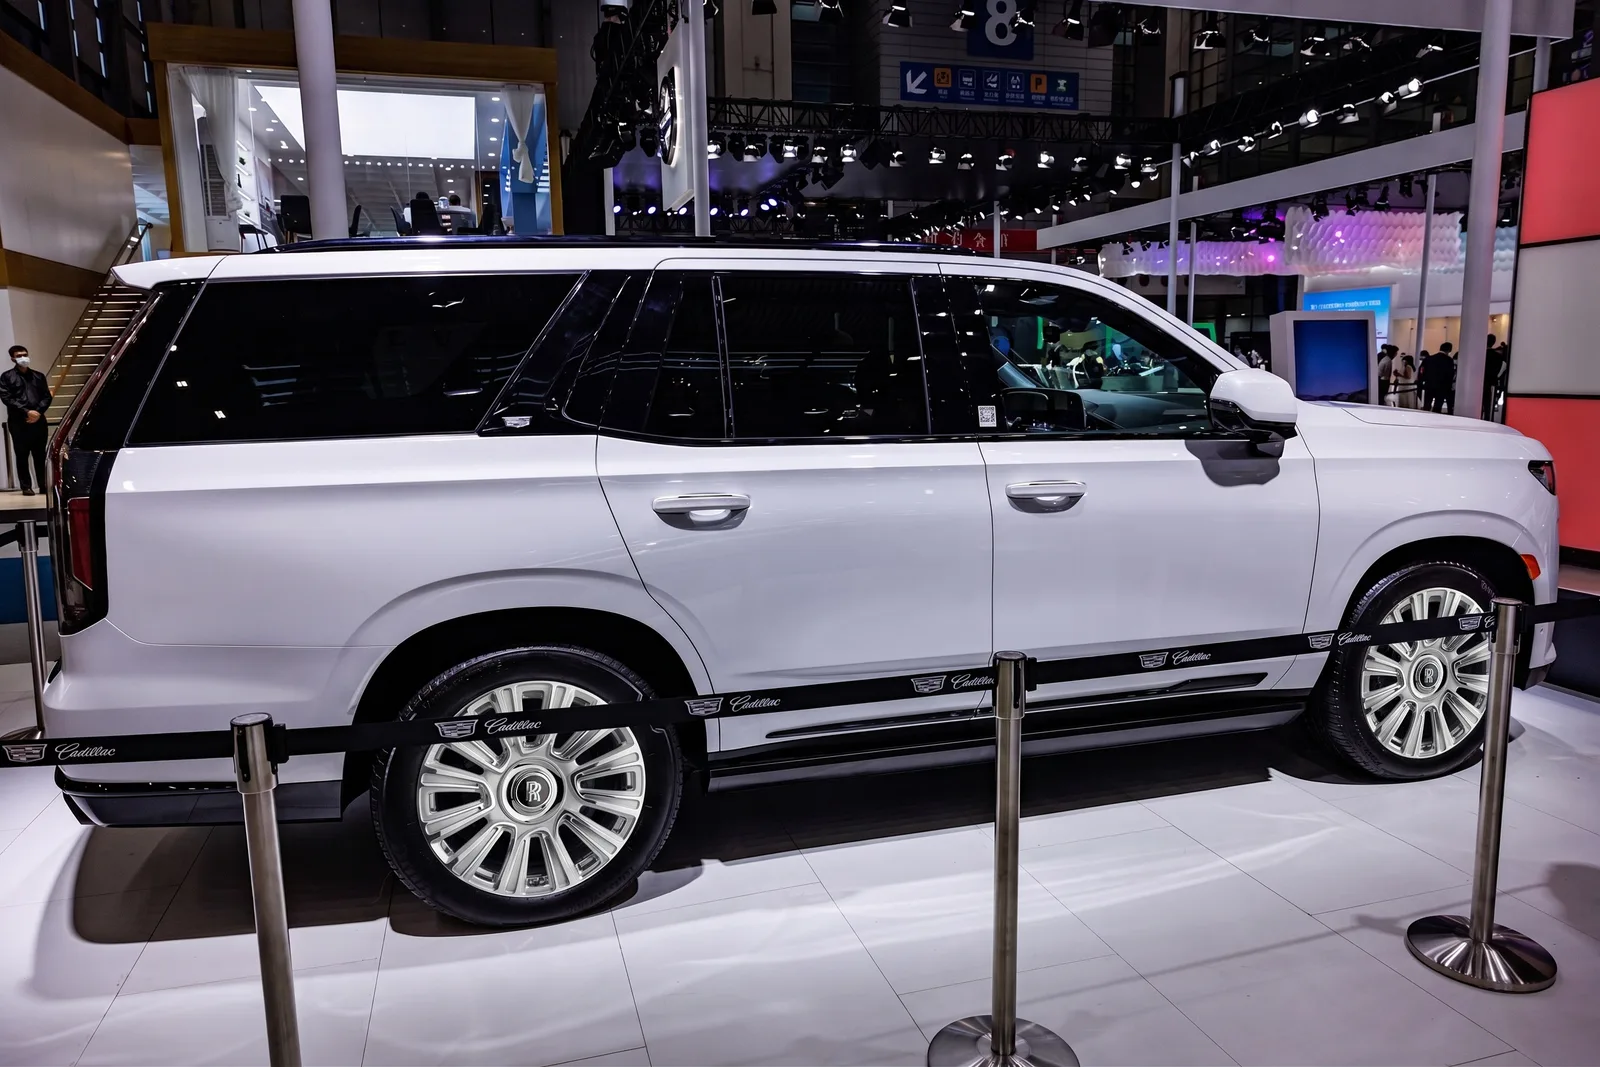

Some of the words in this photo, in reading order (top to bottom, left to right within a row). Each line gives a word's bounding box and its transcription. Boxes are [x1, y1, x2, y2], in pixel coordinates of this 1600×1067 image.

[984, 0, 1018, 46] 8
[1338, 631, 1372, 646] Cadillac
[1172, 650, 1212, 666] Cadillac
[729, 695, 781, 713] Cadillac
[484, 717, 542, 735] Cadillac
[54, 742, 116, 761] Cadillac
